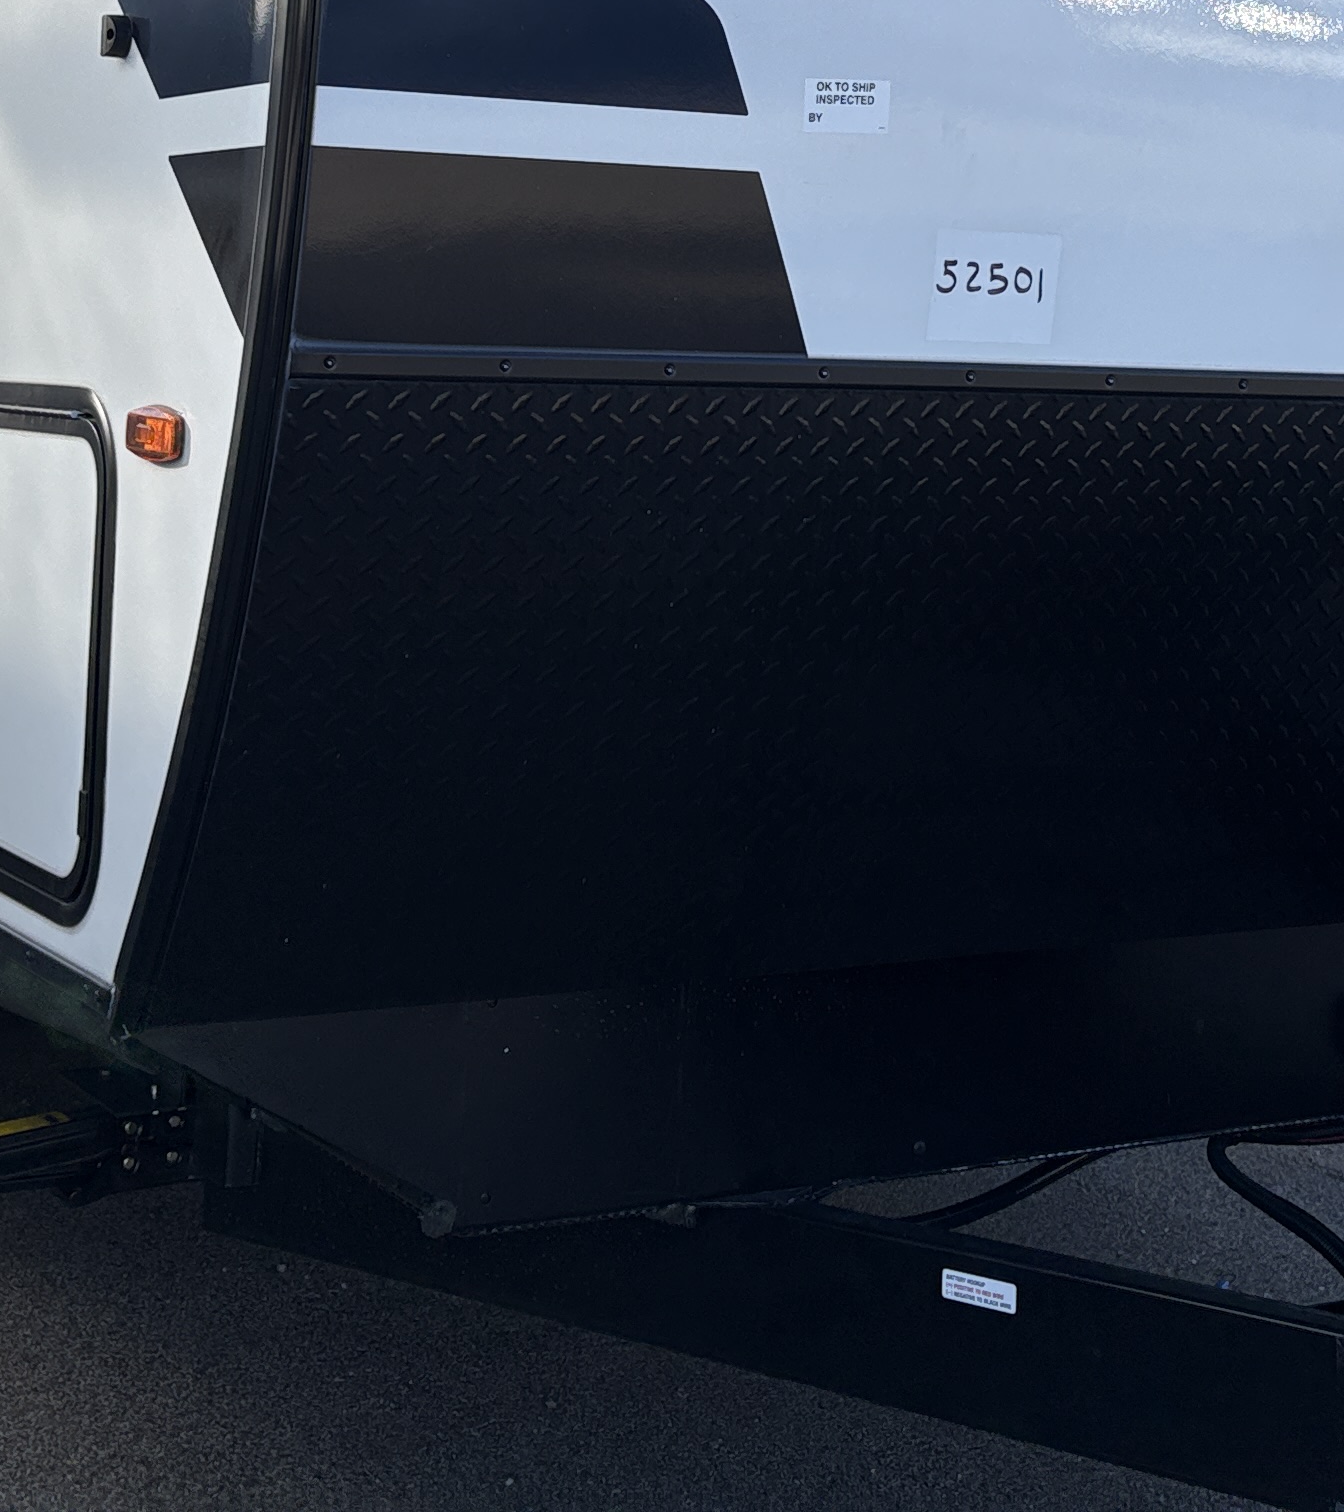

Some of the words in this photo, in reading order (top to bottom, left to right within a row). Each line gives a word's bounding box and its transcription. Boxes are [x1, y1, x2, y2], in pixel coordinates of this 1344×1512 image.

[816, 81, 832, 92] OK
[835, 81, 850, 92] TO
[852, 82, 876, 92] SHIP
[816, 94, 875, 105] INSPECTED
[808, 112, 823, 123] BY
[935, 259, 1044, 304] 52501
